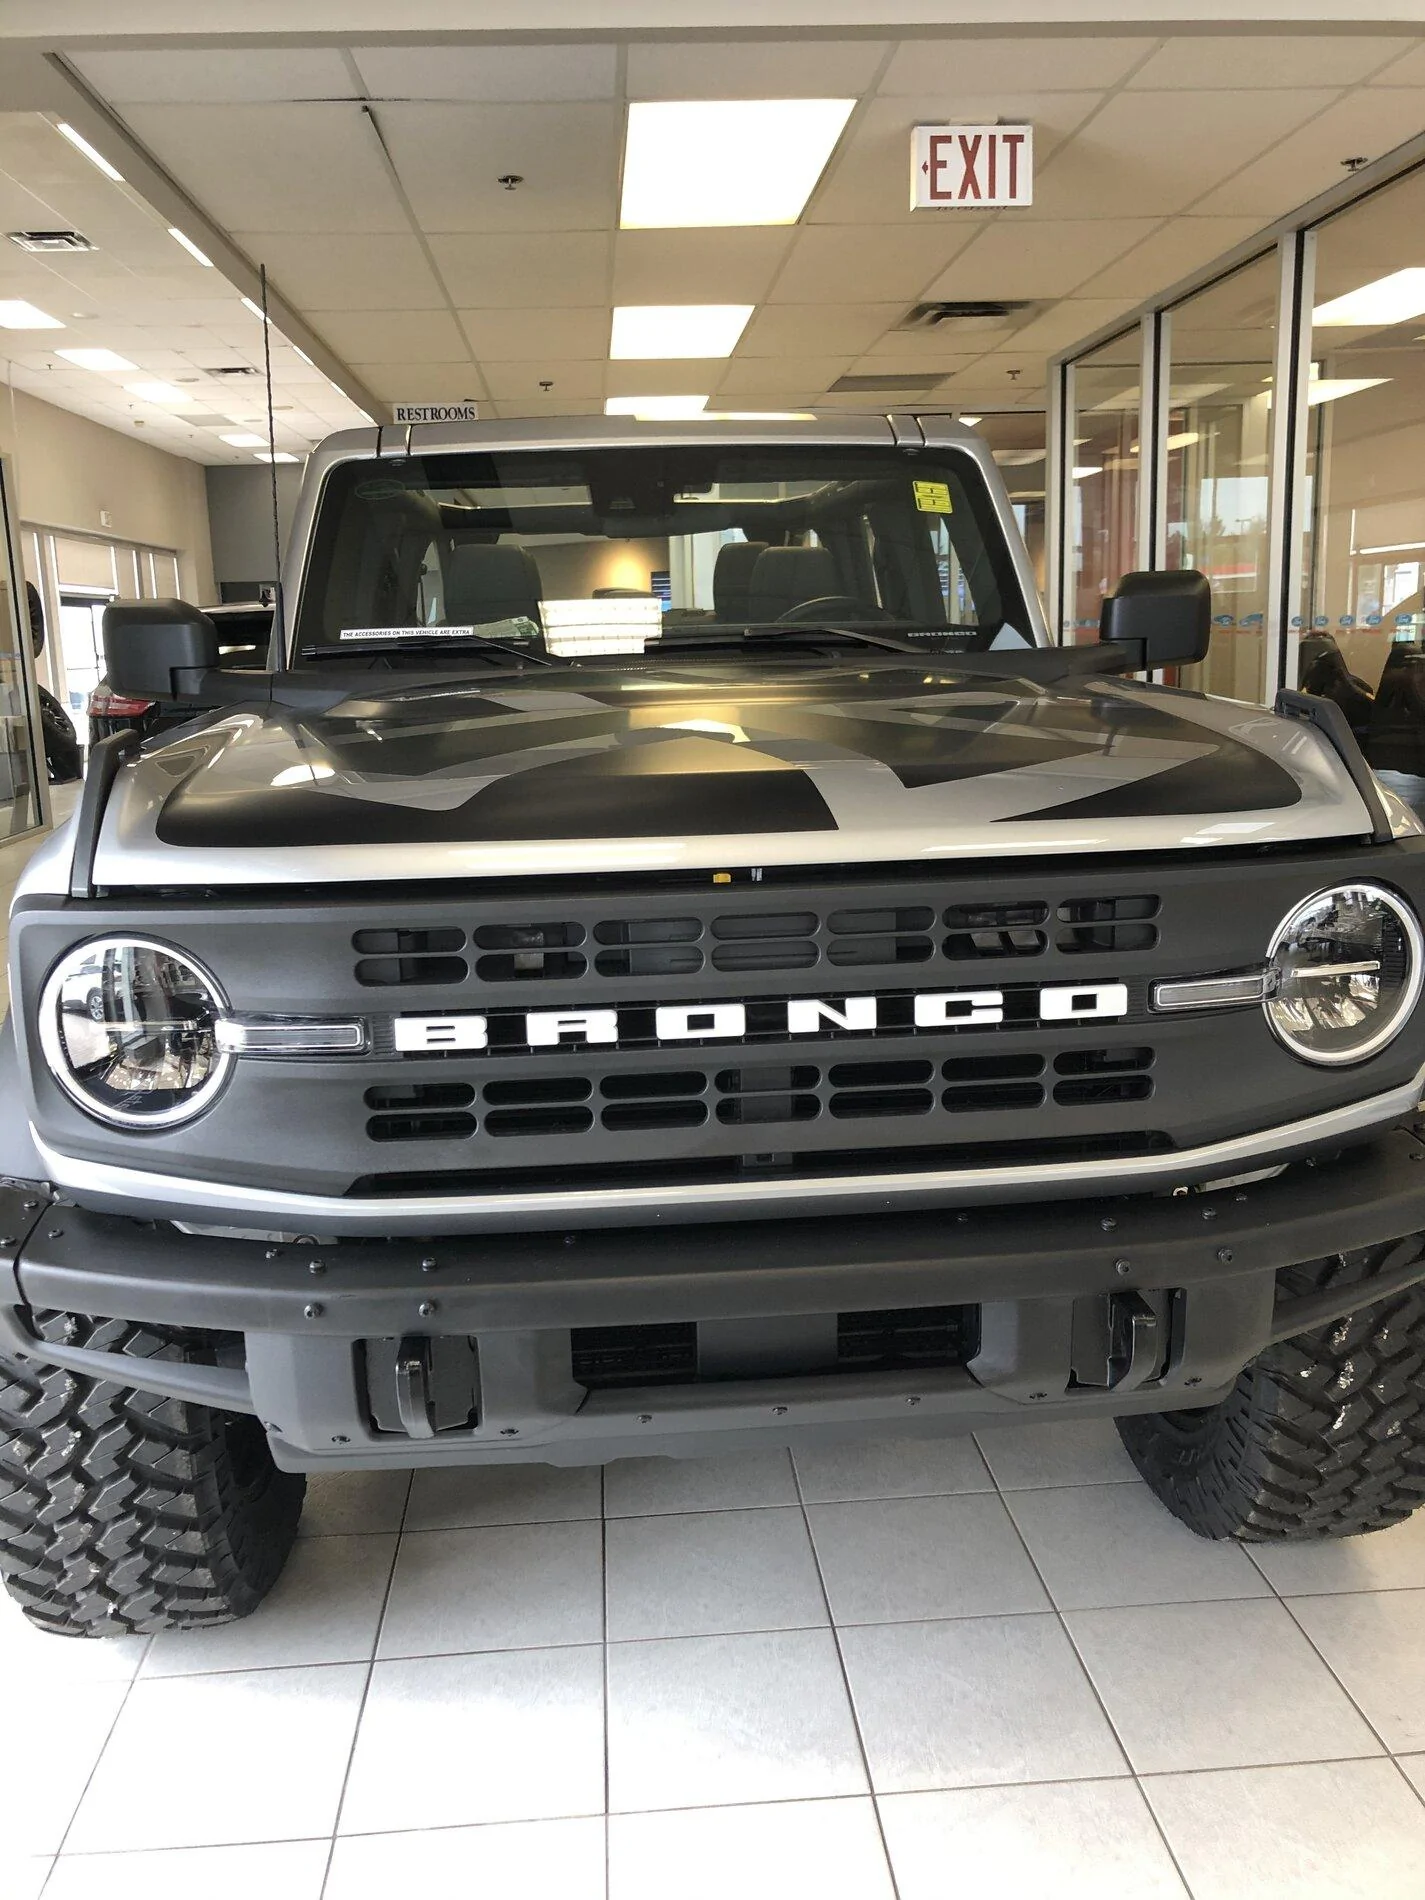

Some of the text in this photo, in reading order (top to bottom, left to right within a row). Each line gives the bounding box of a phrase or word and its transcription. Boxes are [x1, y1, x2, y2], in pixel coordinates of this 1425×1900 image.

[930, 134, 1025, 200] EXIT
[396, 407, 476, 421] RESTROOMS
[395, 983, 1128, 1051] BRONCO
